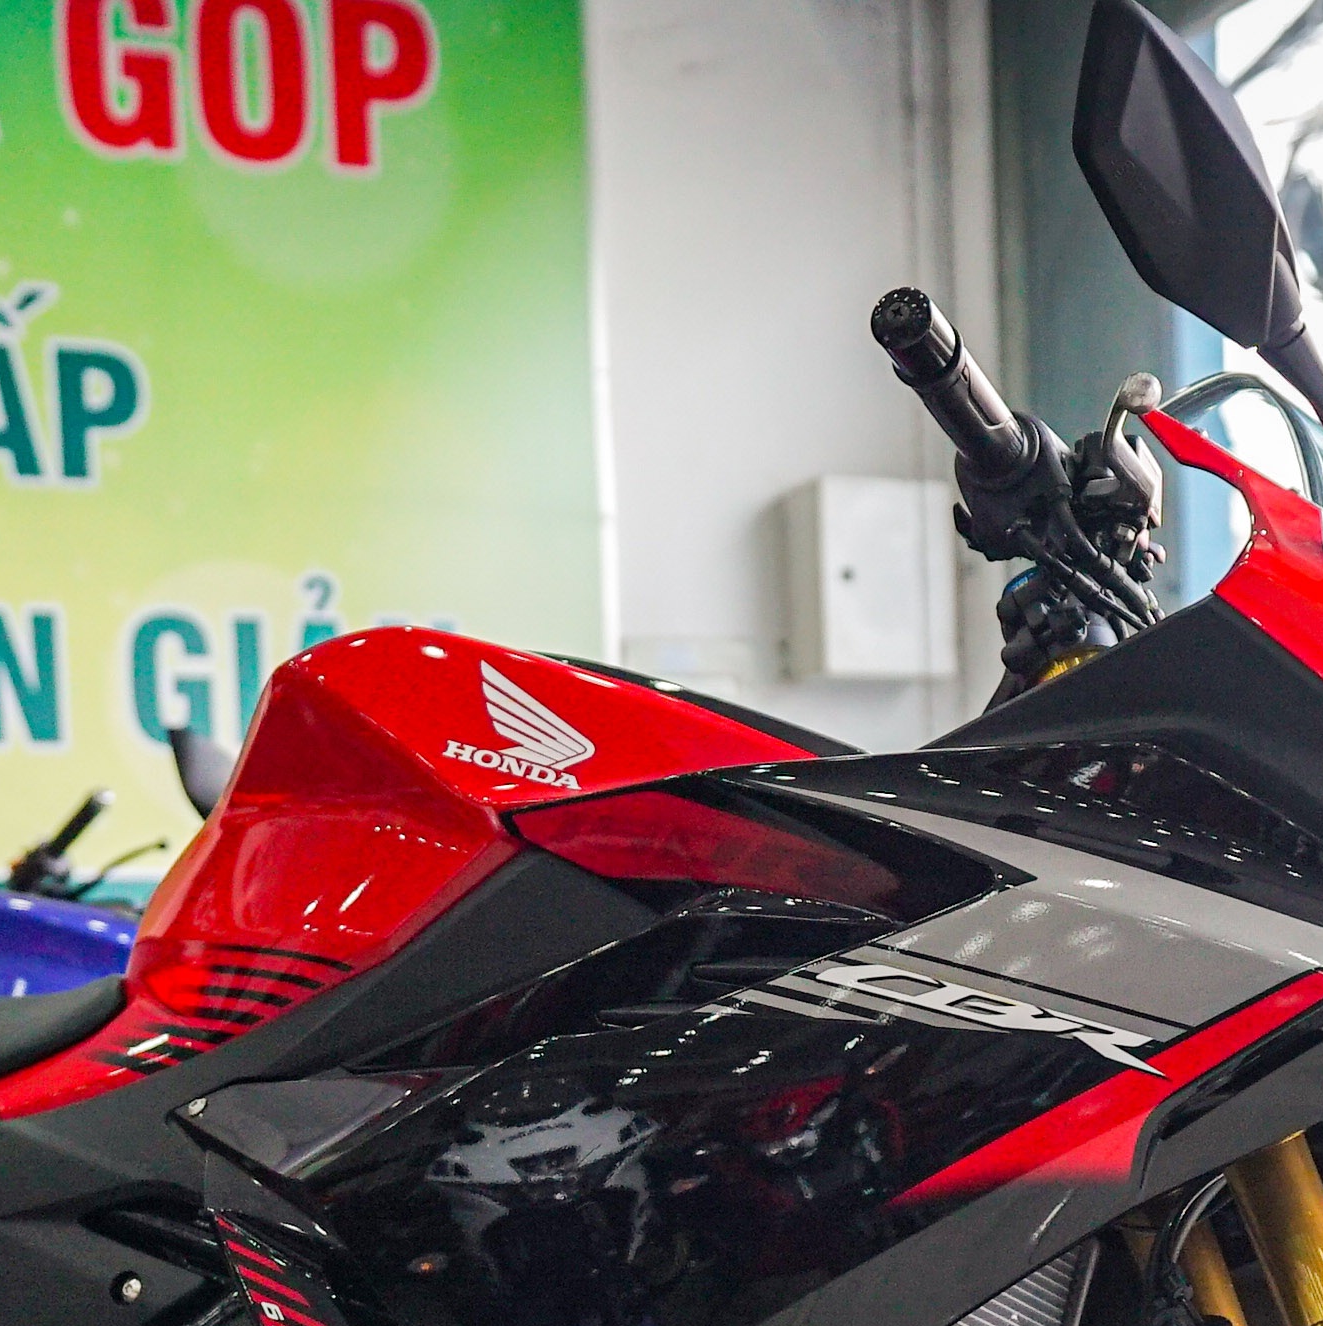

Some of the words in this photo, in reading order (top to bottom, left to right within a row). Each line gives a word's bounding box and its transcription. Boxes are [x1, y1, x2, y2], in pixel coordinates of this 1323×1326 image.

[441, 739, 582, 790] HONDA
[815, 964, 1168, 1078] CBR
[260, 1301, 284, 1321] 6
